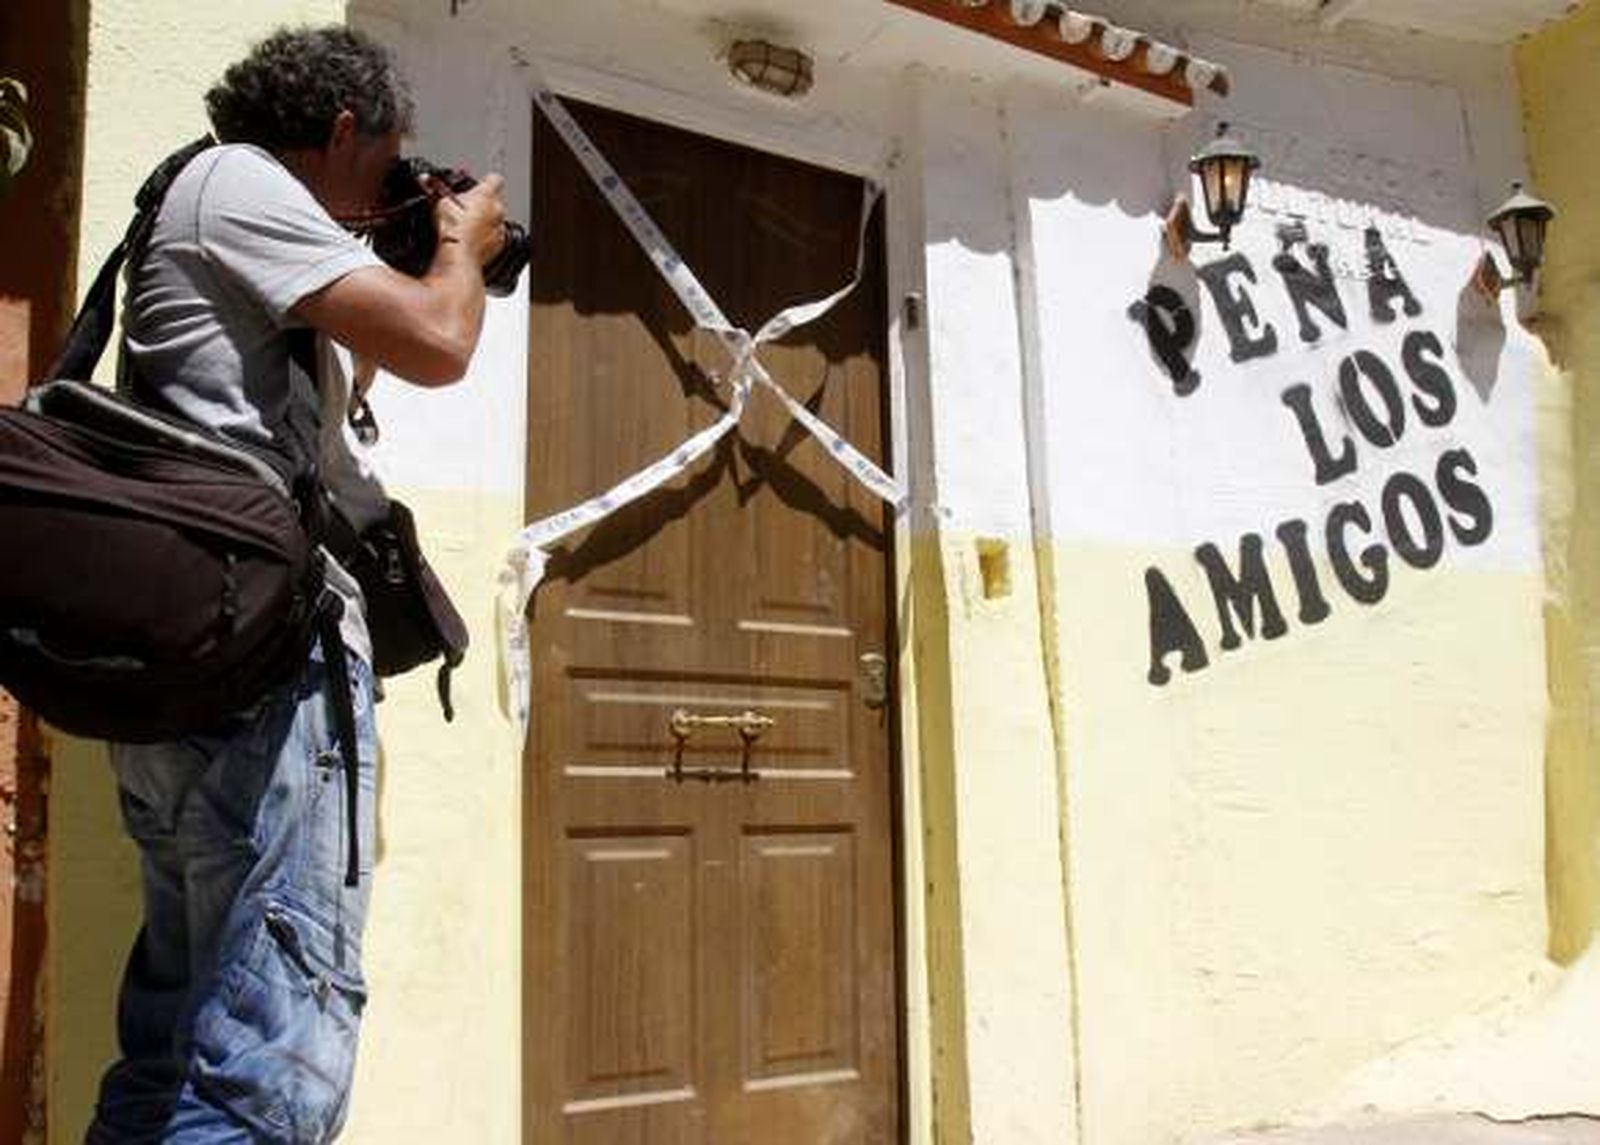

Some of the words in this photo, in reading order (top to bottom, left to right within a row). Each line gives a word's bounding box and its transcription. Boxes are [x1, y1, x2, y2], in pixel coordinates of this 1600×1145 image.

[1127, 222, 1422, 396] PEÑA
[1281, 331, 1456, 485] LOS
[1144, 449, 1493, 686] AMIGOS
